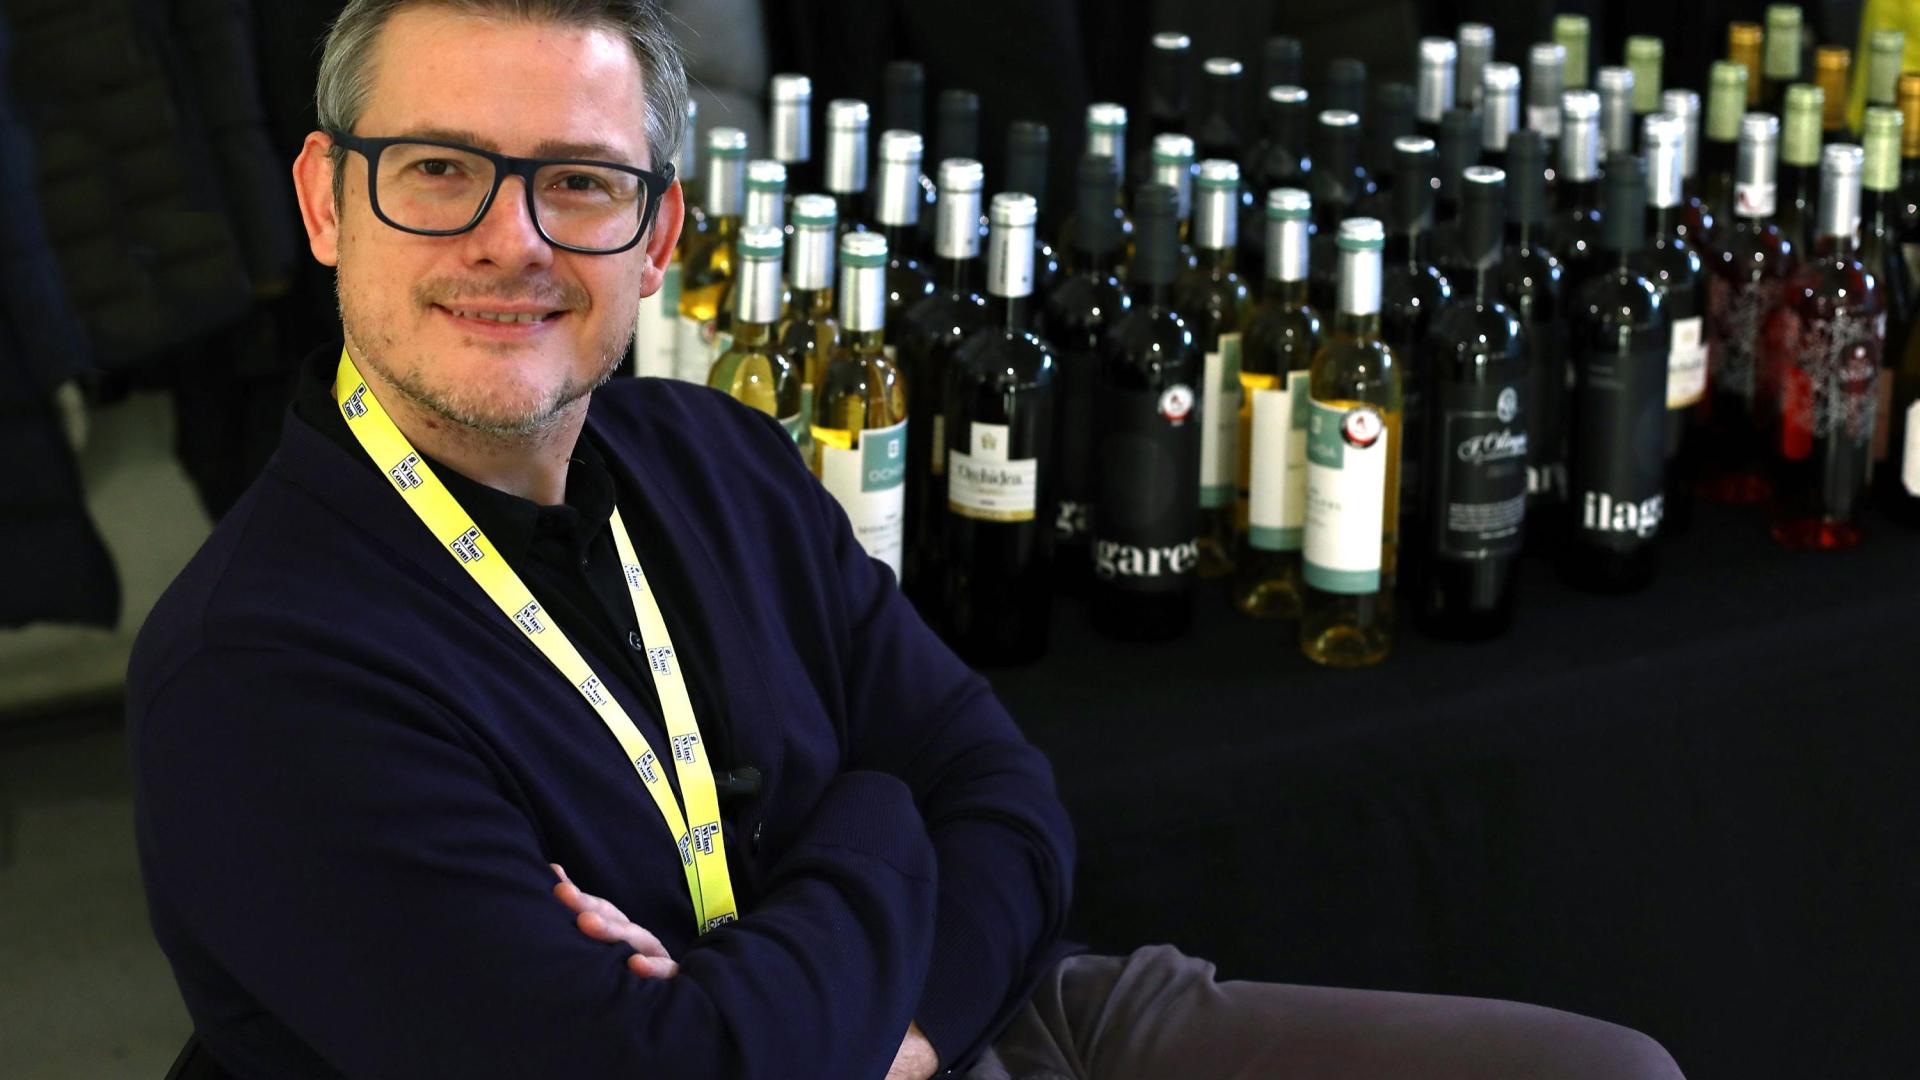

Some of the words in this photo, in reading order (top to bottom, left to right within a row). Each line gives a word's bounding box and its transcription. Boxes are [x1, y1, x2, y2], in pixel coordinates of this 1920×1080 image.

[344, 402, 354, 417] Com
[352, 394, 364, 414] Wine
[392, 470, 408, 488] Com
[401, 463, 419, 485] Wine
[453, 542, 469, 561] Com
[461, 536, 480, 558] Wine
[516, 614, 532, 632] Com
[524, 609, 541, 630] Wine
[650, 650, 658, 670] Com
[658, 650, 667, 672] Wine
[674, 738, 682, 759] Com
[682, 737, 691, 761] Wine
[642, 758, 655, 780] Wine
[694, 829, 702, 850] Com
